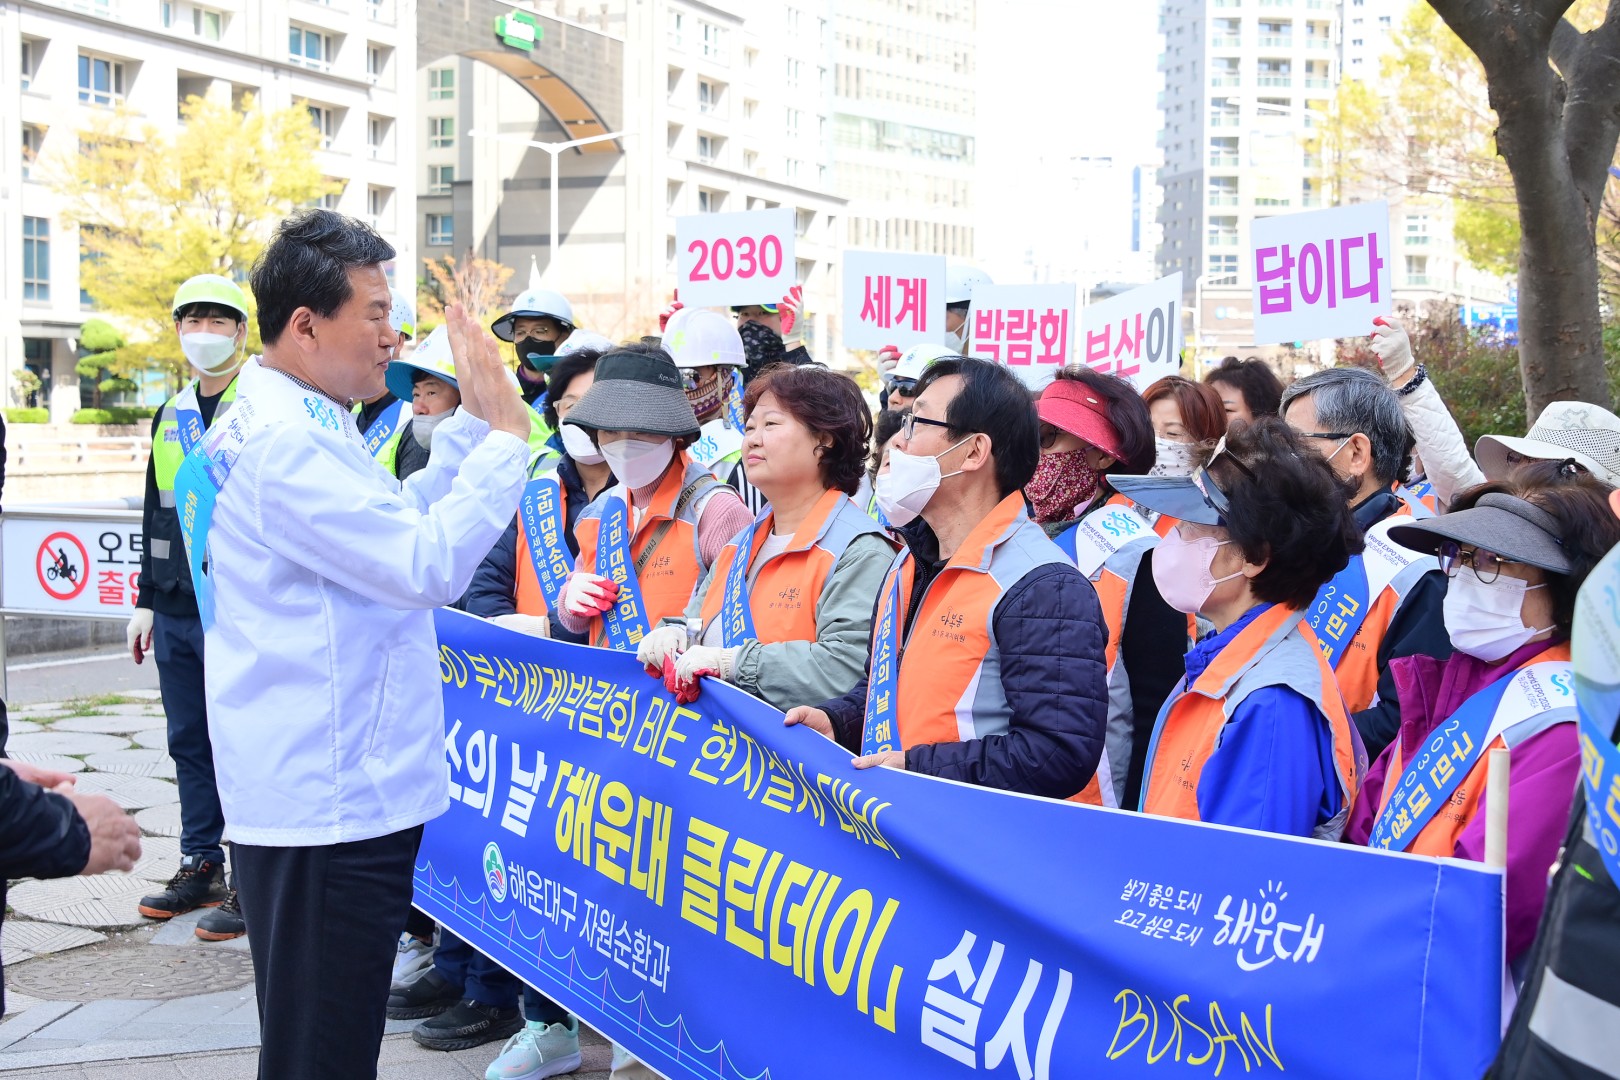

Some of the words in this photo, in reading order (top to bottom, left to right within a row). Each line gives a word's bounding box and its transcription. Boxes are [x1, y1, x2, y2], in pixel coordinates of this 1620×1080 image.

[687, 234, 783, 282] 2030
[1256, 232, 1384, 315] 답이다
[860, 275, 928, 332] 세계
[974, 308, 1069, 367] 박람회
[1086, 301, 1176, 379] 부산이
[536, 486, 554, 516] 구민
[609, 509, 623, 547] 구민
[540, 515, 571, 580] 대청소의
[1368, 533, 1384, 549] World
[1381, 543, 1397, 557] EXPO
[1394, 553, 1410, 566] 2030
[609, 546, 639, 622] 대청소의
[732, 565, 746, 639] 대청소의
[625, 623, 644, 645] 날
[877, 593, 894, 685] 대청소의
[1324, 593, 1360, 641] 구민
[865, 712, 874, 743] 부산
[876, 689, 891, 715] 날
[462, 649, 640, 748] 부산세계박람회
[633, 696, 702, 768] BIE
[688, 718, 826, 827] 현지실사
[816, 772, 901, 860] 대비
[1429, 730, 1475, 791] 구민
[500, 741, 548, 838] 날
[920, 929, 1073, 1080] 실시
[507, 860, 578, 933] 해운대구
[579, 898, 671, 994] 자원순환과
[1120, 878, 1150, 903] 살기
[1148, 883, 1175, 911] 좋은
[1173, 889, 1203, 916] 도시
[1113, 908, 1147, 929] 오고
[1140, 915, 1175, 940] 싶은
[1169, 922, 1204, 948] 도시
[1212, 893, 1326, 972] 해운대
[1105, 988, 1286, 1078] BUSAN
